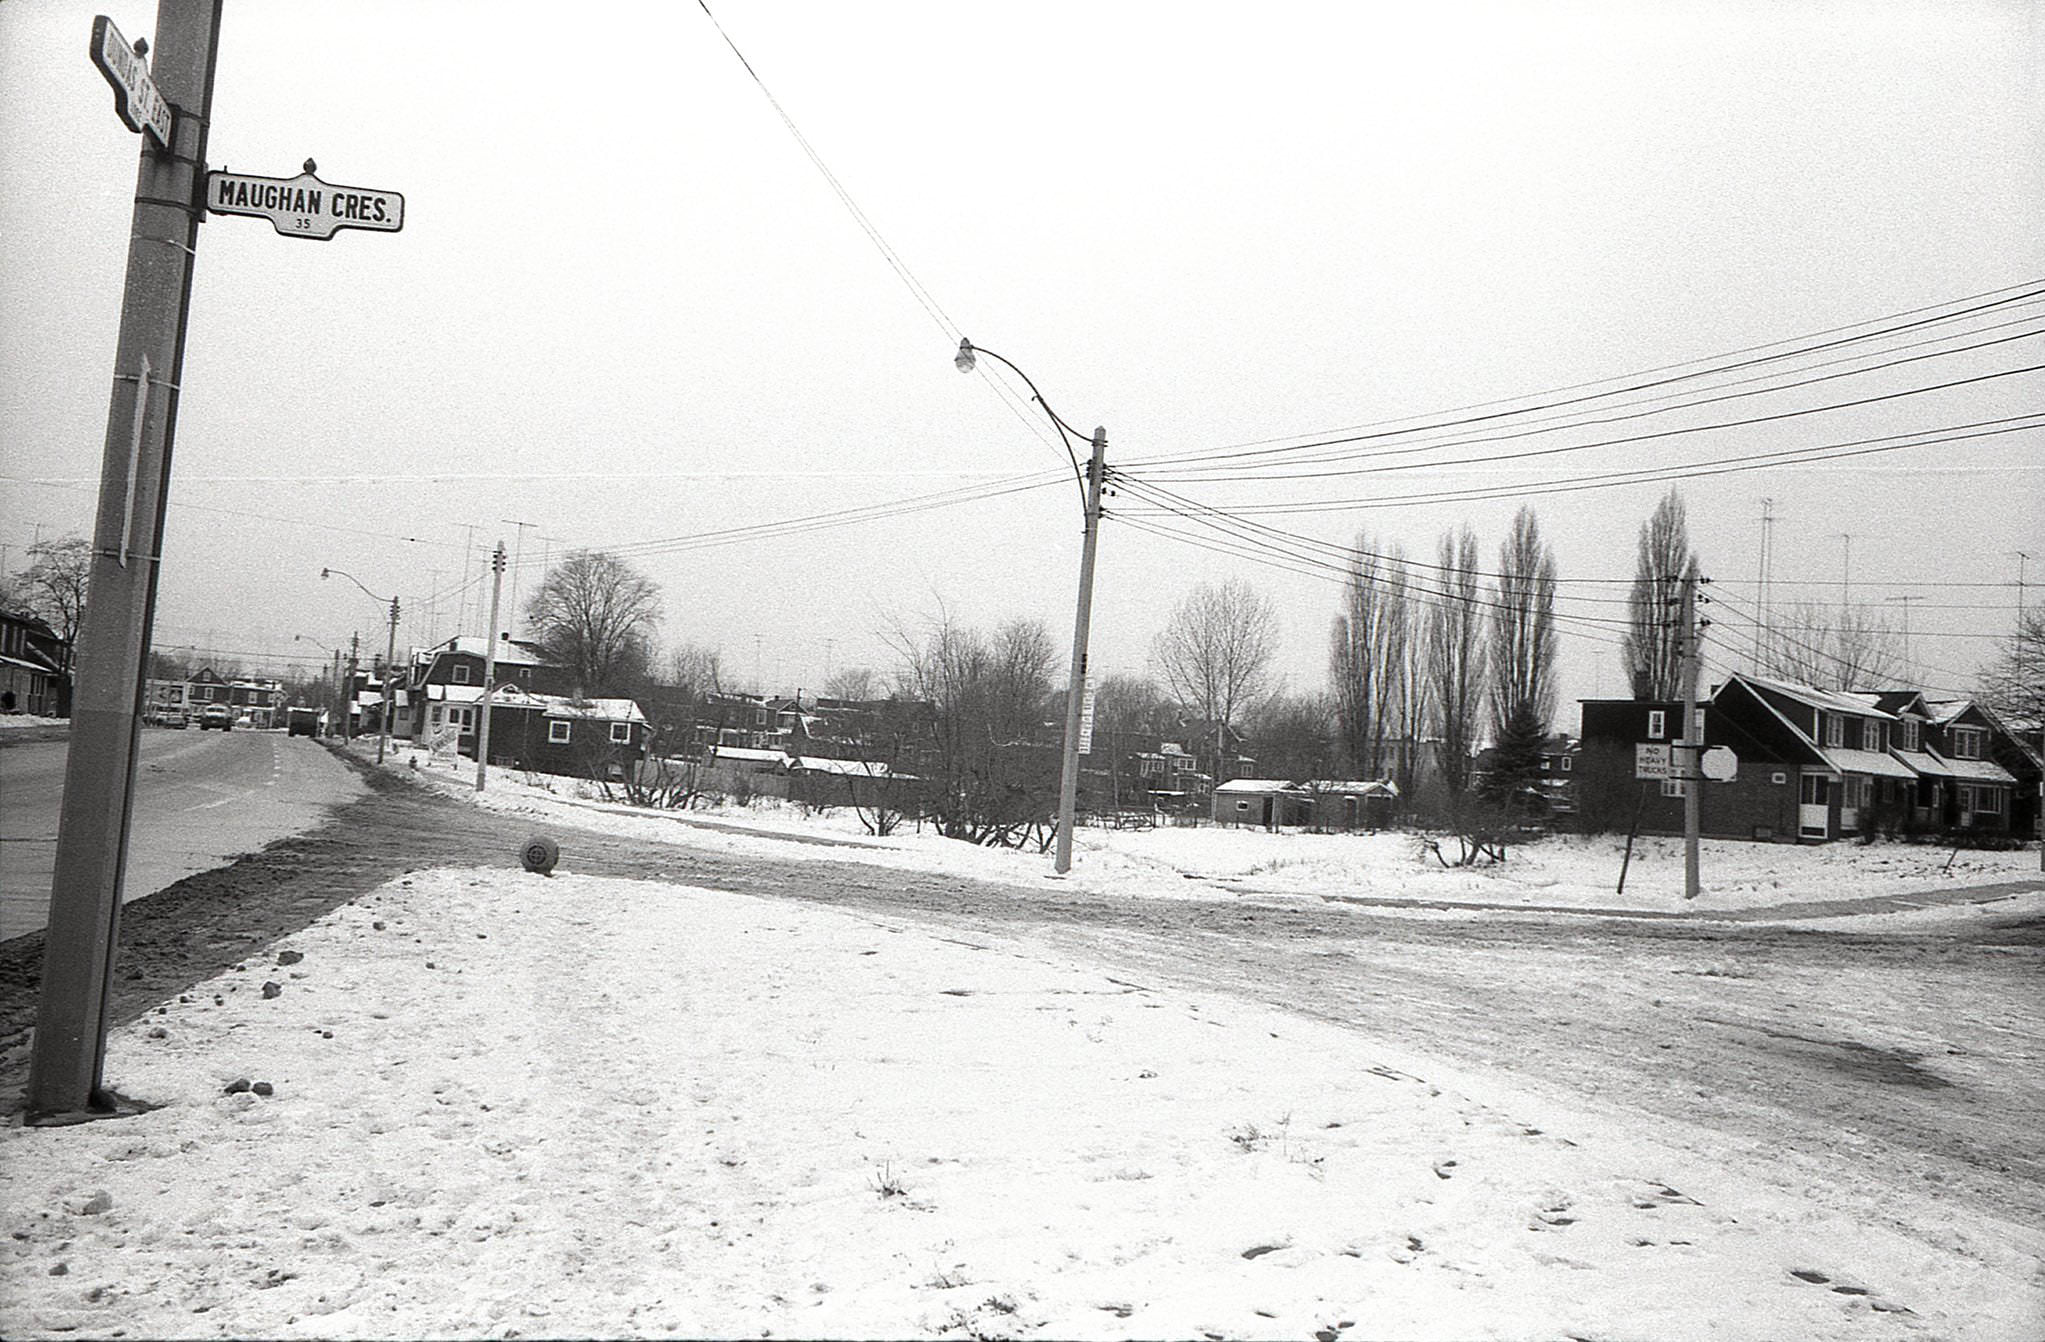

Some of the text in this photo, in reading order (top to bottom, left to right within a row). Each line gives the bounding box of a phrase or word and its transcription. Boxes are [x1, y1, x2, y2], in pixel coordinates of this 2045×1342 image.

[219, 179, 392, 223] MAUGHAN CRES.
[296, 218, 311, 229] 35
[1646, 747, 1660, 756] NO
[1639, 756, 1666, 765] HEAVY
[1639, 765, 1667, 774] TRUCKS
